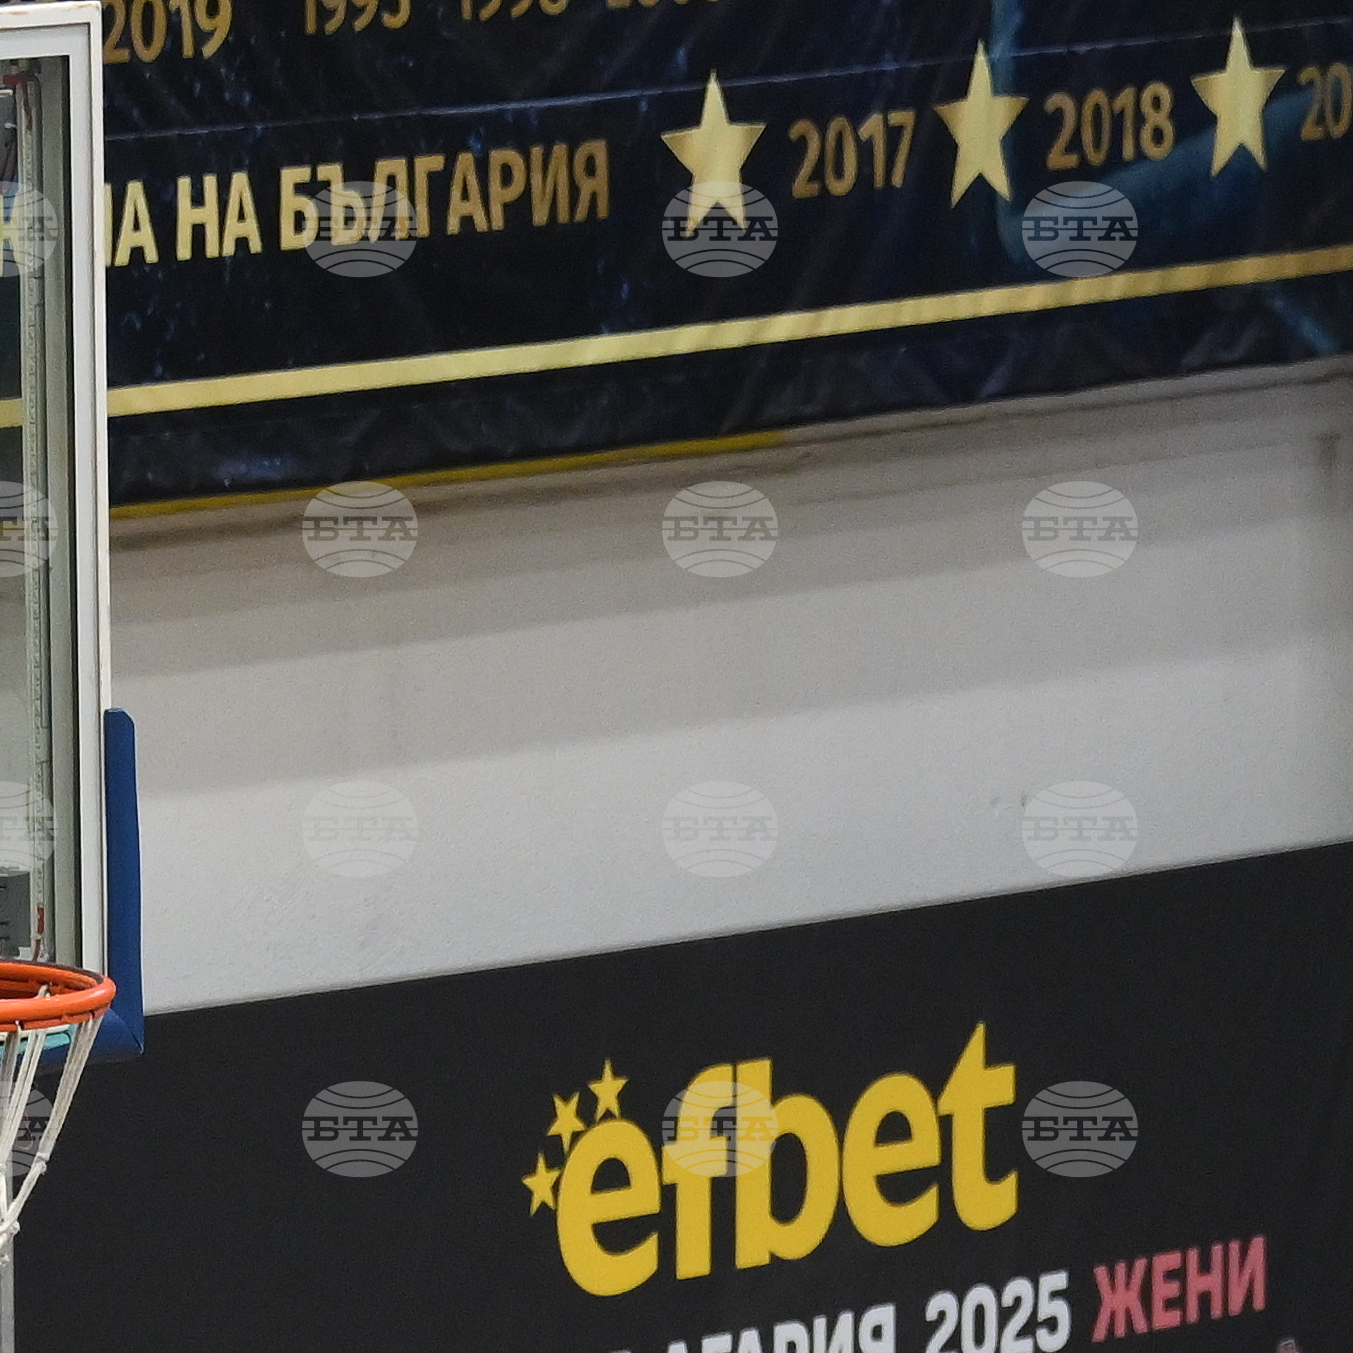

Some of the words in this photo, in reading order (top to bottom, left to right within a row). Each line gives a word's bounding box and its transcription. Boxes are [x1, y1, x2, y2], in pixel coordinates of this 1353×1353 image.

[102, 0, 233, 63] 2019
[788, 108, 917, 199] 2017
[1045, 80, 1177, 170] 2018
[1298, 61, 1353, 141] 20
[175, 170, 263, 262] НА
[278, 139, 609, 251] БЪЛГАРИЯ
[553, 1020, 1020, 1297] efbet
[1091, 1234, 1268, 1344] ЖЕНИ
